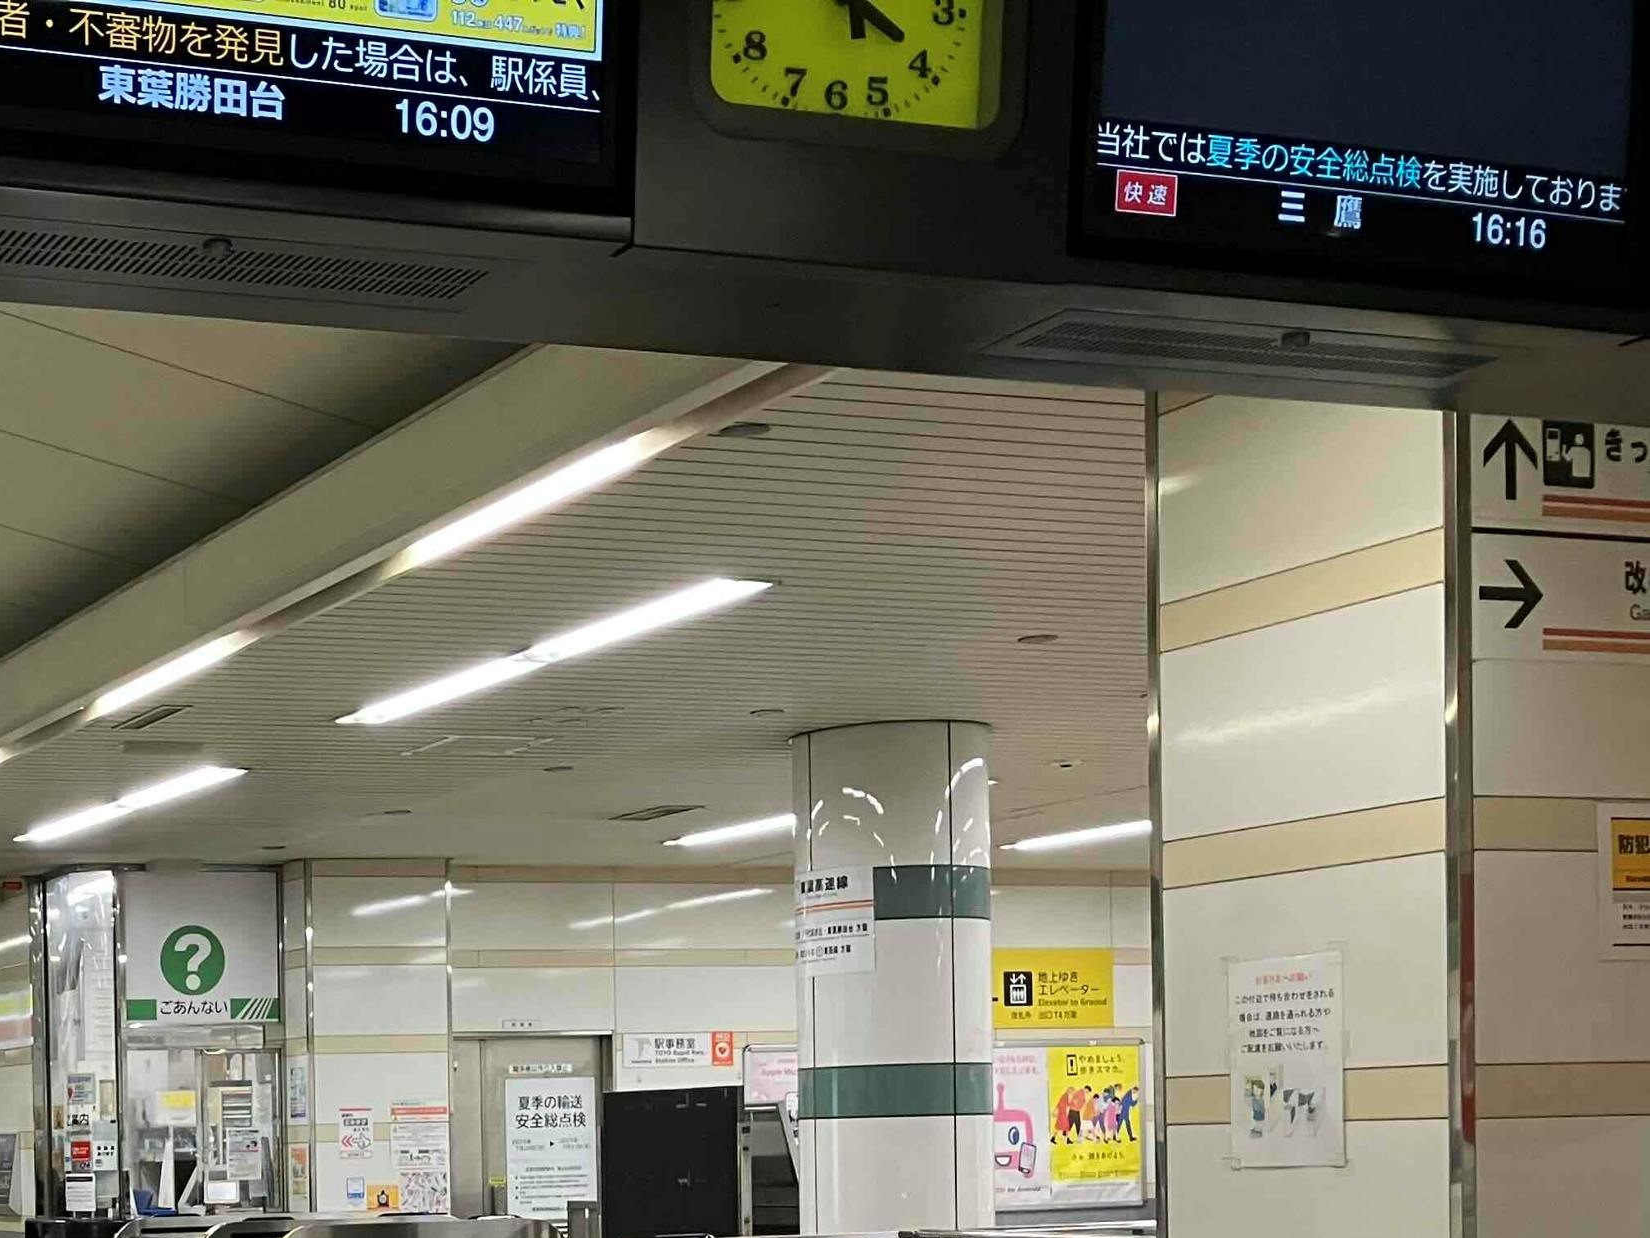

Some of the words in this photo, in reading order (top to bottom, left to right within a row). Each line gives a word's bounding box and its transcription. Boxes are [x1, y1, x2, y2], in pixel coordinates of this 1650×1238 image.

[743, 30, 767, 61] 8
[908, 49, 933, 78] 4
[99, 64, 286, 122] 東葉勝田台
[784, 66, 808, 98] 7
[824, 80, 848, 110] 6
[867, 76, 889, 106] 5
[395, 98, 496, 143] 16:09
[1097, 122, 1628, 214] 当社では夏季の安全総点検を実施しておりま
[1123, 183, 1169, 208] 快速
[1471, 211, 1548, 250] 16:16
[1038, 984, 1100, 996] エレベーター
[160, 1000, 228, 1016] ごあんない
[517, 1095, 582, 1111] 夏季の輸送
[515, 1112, 586, 1129] 安全総点検
